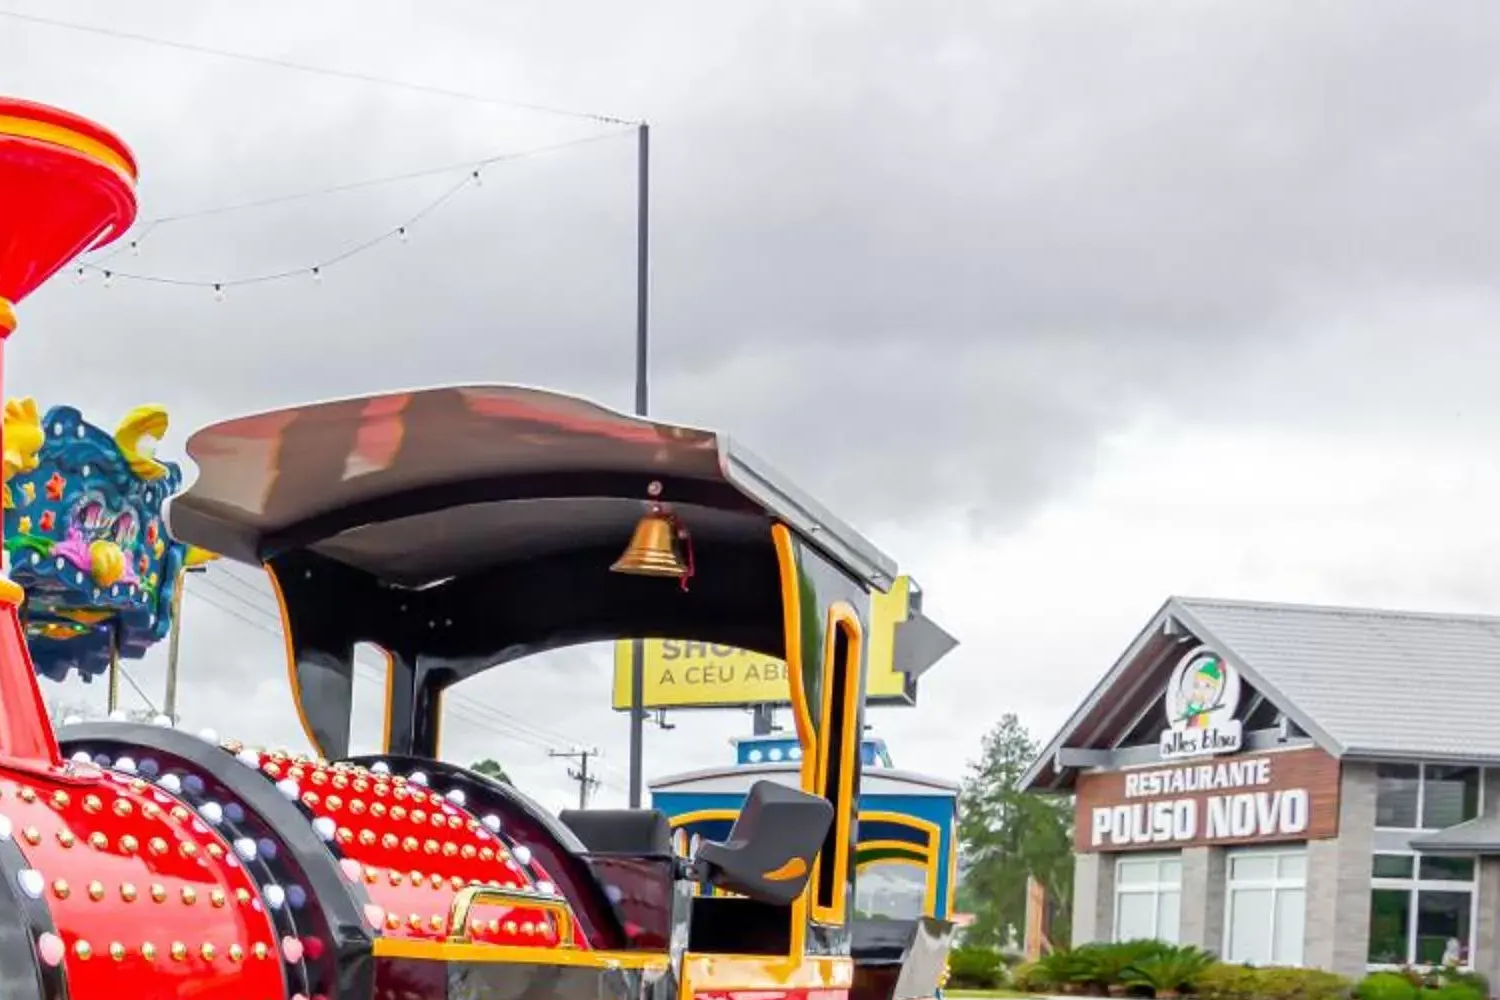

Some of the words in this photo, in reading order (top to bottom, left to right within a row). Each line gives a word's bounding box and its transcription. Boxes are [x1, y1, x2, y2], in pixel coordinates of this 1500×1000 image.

[662, 640, 747, 660] SHO
[660, 669, 676, 685] A
[685, 661, 734, 684] CÉU
[1125, 758, 1271, 798] RESTAURANTE
[1092, 798, 1198, 846] POUSO
[1206, 788, 1309, 839] NOVO
